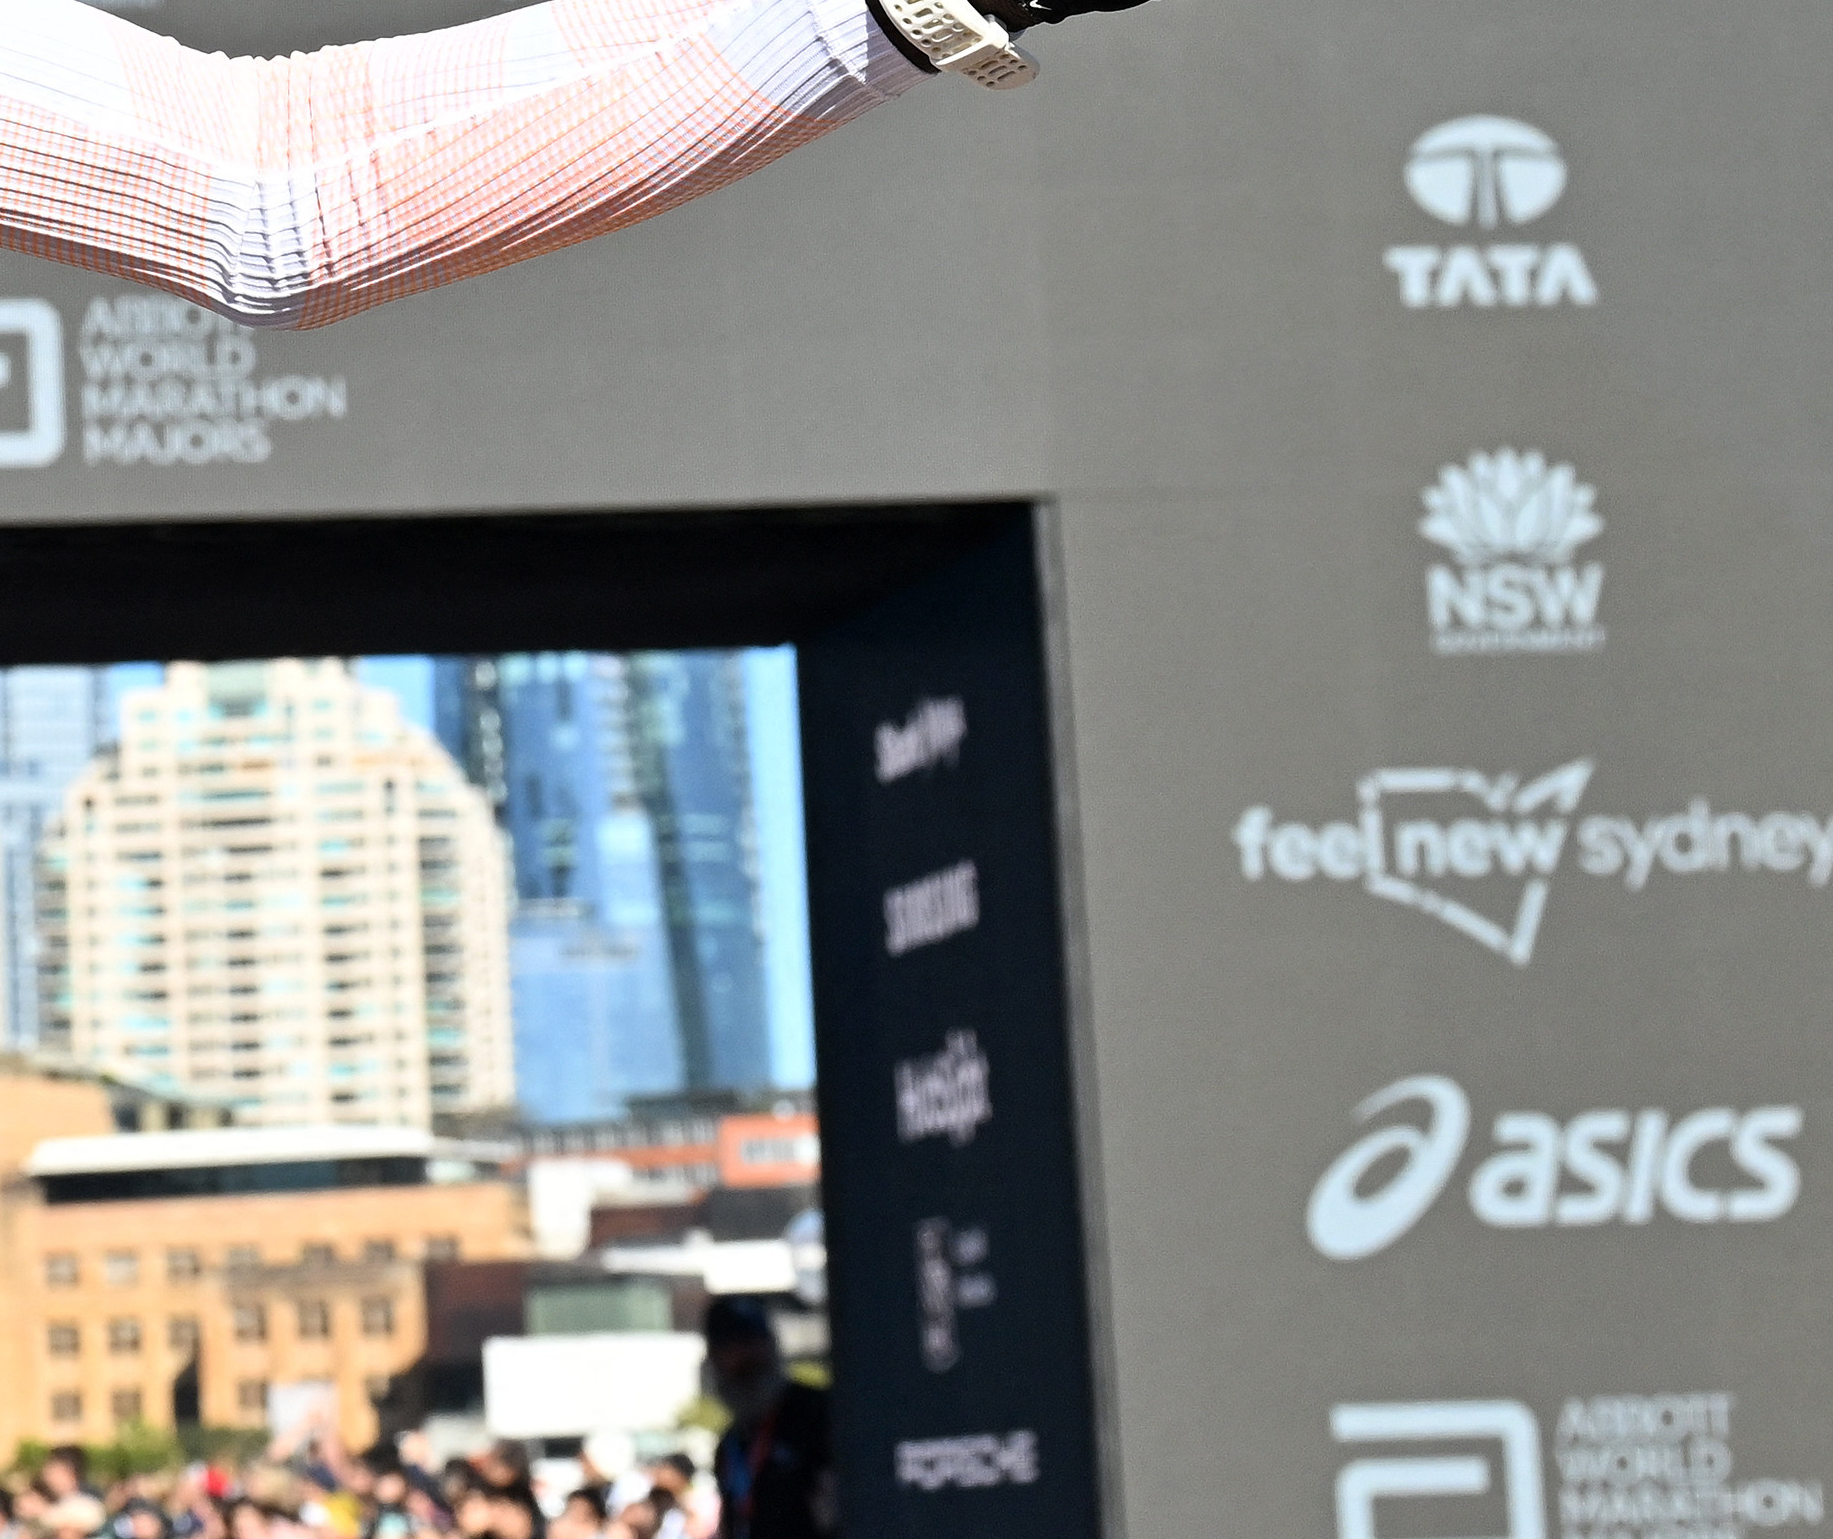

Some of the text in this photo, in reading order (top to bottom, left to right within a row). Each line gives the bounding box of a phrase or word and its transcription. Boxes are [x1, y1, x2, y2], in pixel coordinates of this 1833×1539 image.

[1383, 243, 1597, 307] TATA
[1426, 562, 1605, 629] NSW
[1234, 795, 1833, 892] feel new sydney
[1467, 1104, 1806, 1229] asics
